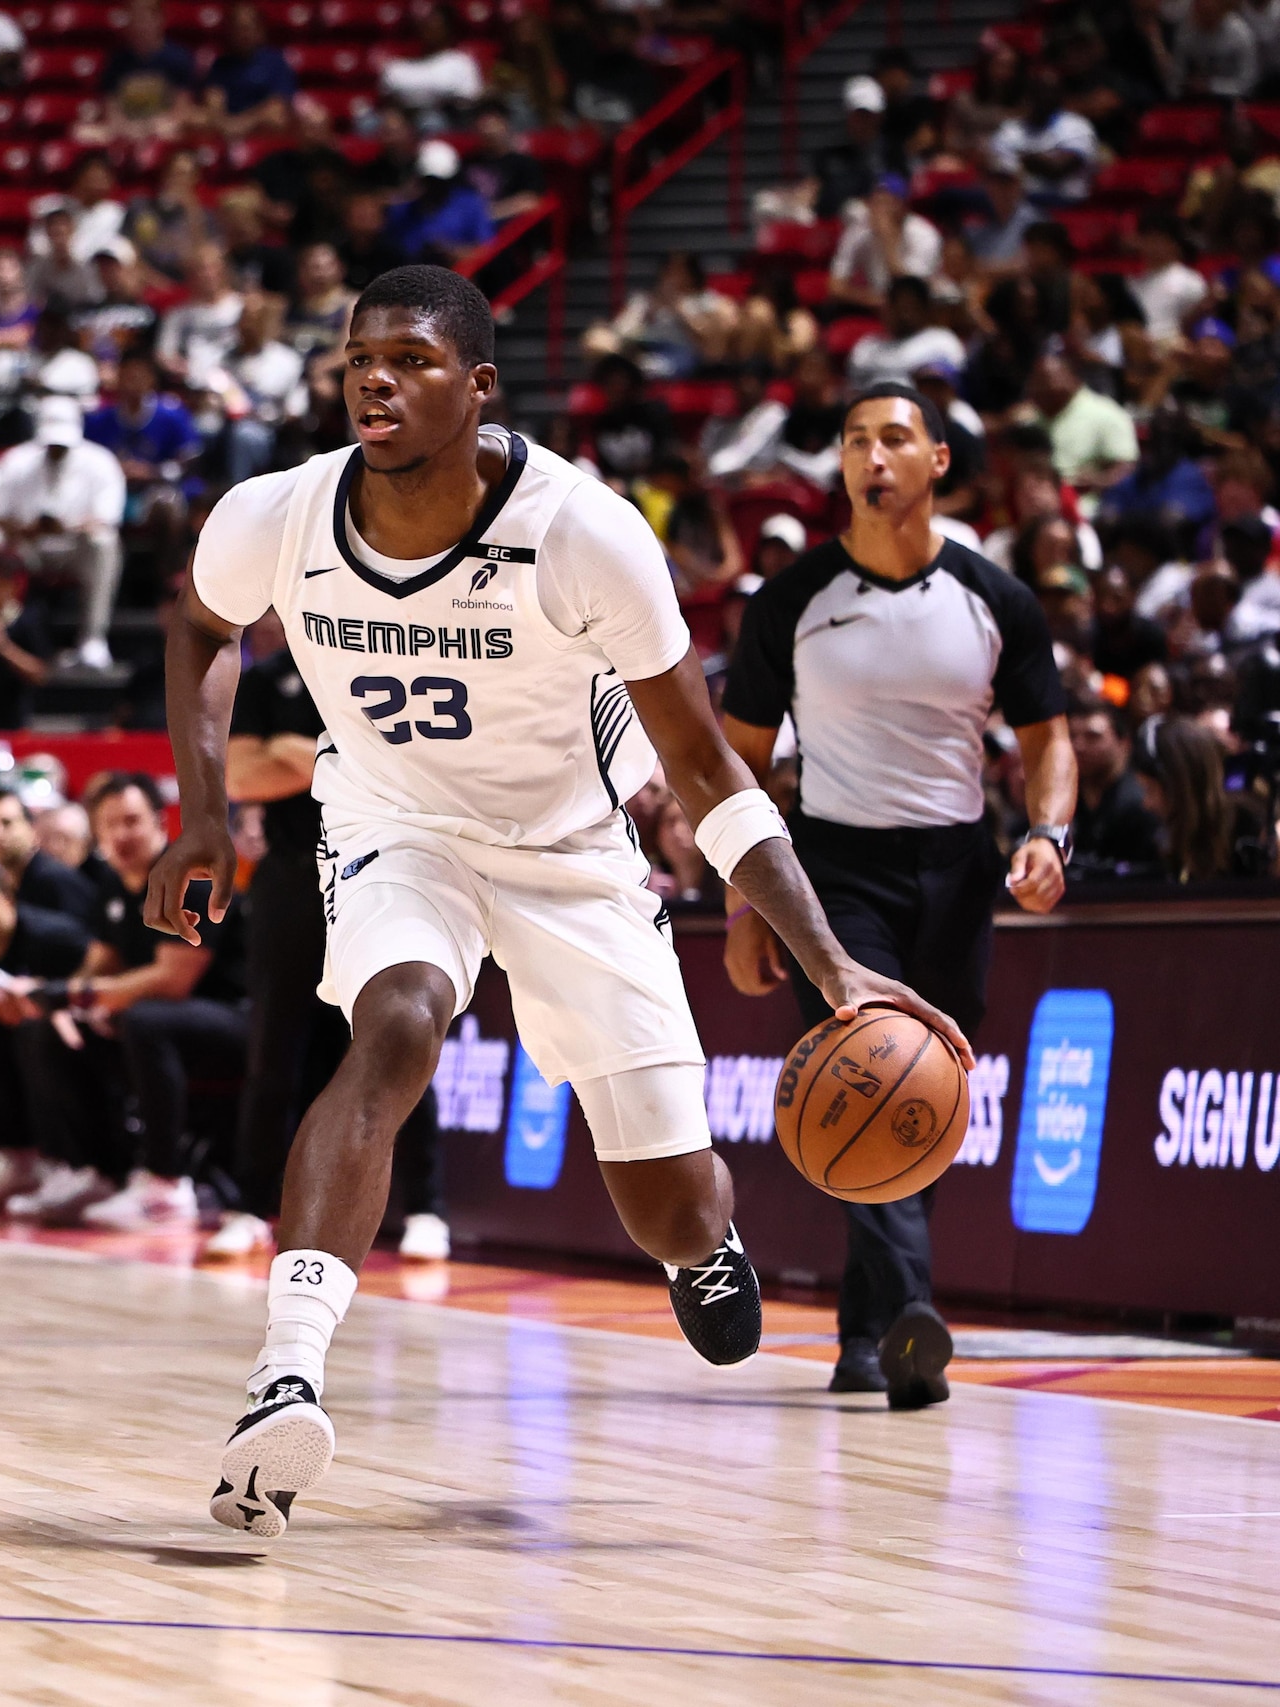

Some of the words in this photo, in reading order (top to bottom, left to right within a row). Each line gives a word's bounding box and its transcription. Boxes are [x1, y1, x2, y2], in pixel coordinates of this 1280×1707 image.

[487, 547, 511, 560] BC
[452, 598, 513, 611] Robinhood
[301, 611, 514, 659] MEMPHIS
[350, 676, 473, 745] 23
[777, 1013, 862, 1108] Wilso
[1154, 1066, 1254, 1169] SIGN
[290, 1259, 324, 1285] 23
